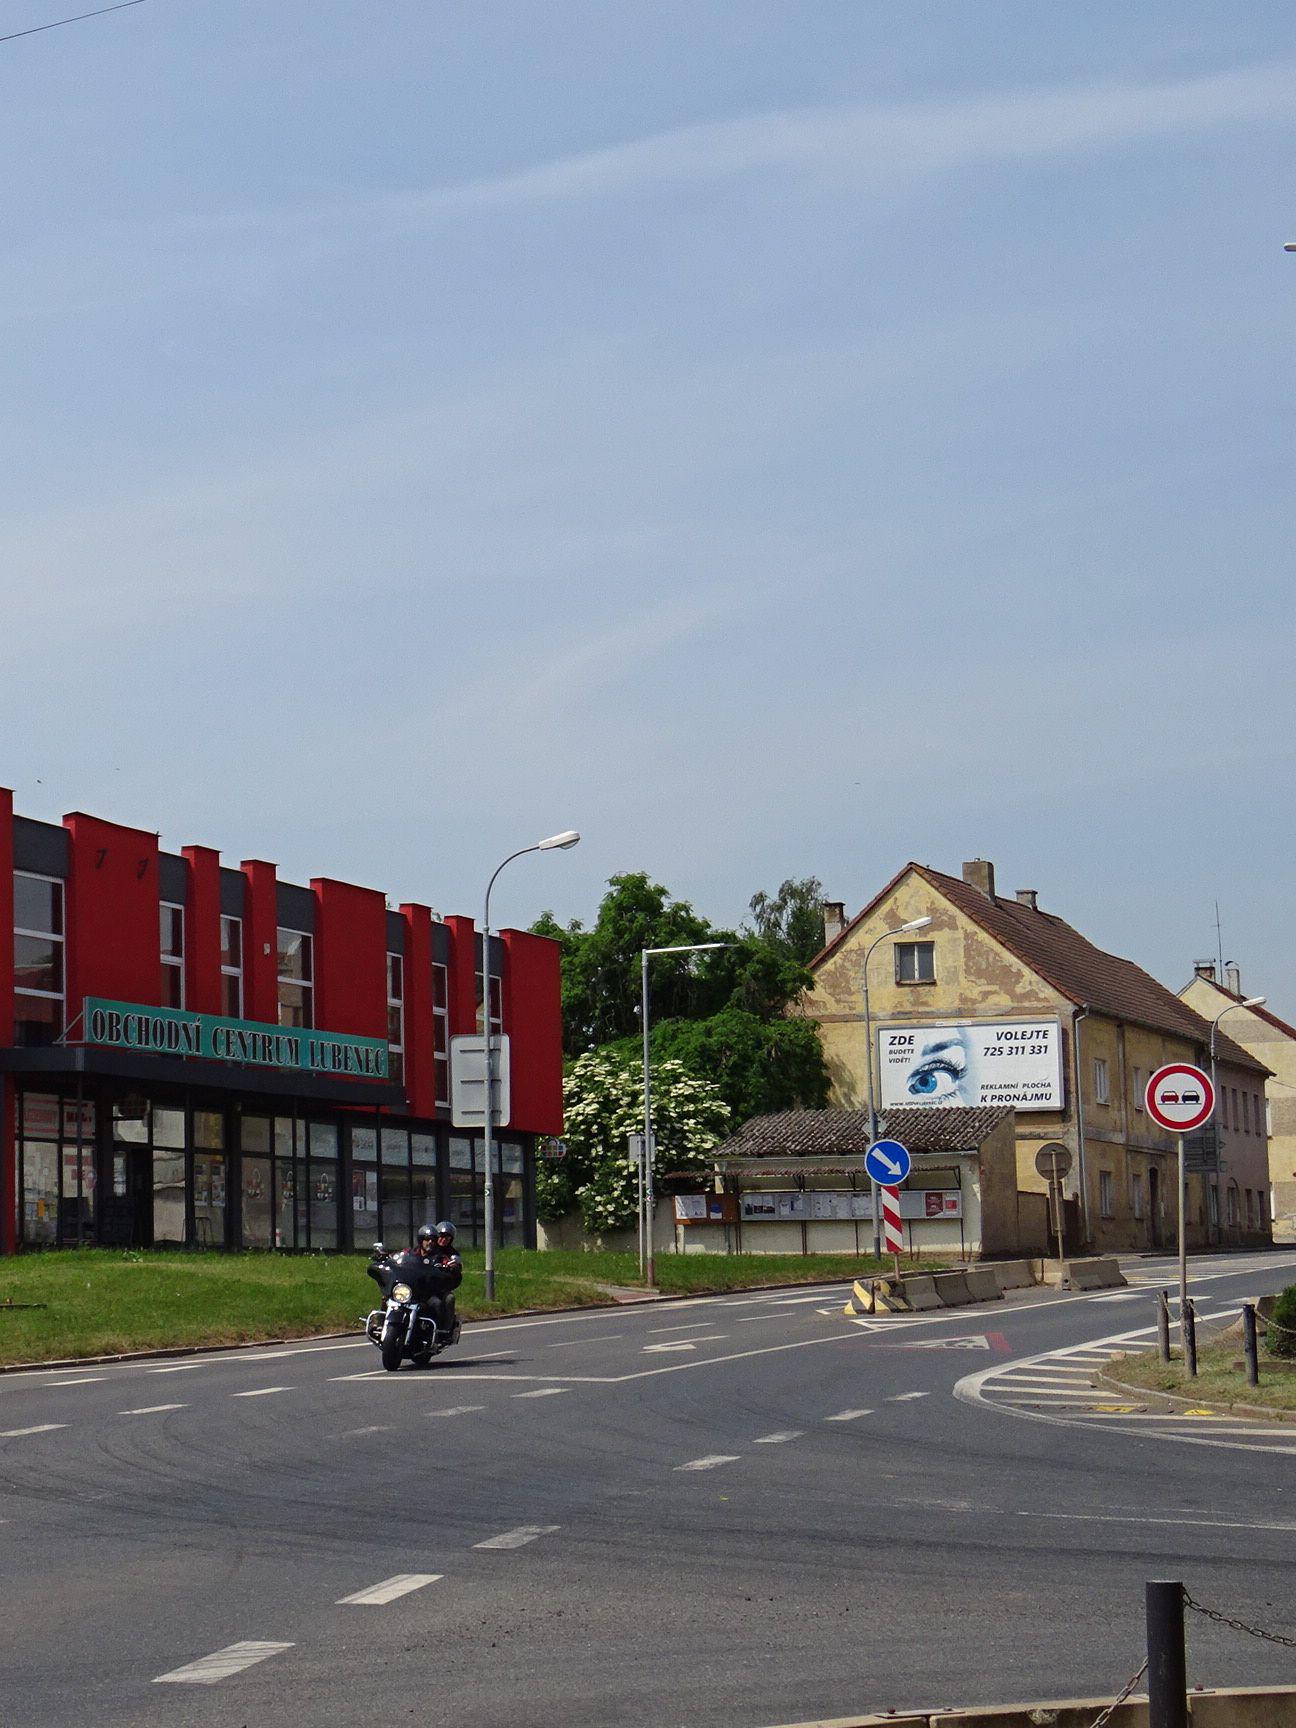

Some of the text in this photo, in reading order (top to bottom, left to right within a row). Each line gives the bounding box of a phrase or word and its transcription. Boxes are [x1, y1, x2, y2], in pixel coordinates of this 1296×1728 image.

[888, 1035, 915, 1046] ZDE
[996, 1029, 1049, 1041] VOLEJTE
[91, 1008, 386, 1077] OBCHODNÍ CENTRUM LUBENEC
[983, 1044, 1049, 1057] 725 311 331
[980, 1082, 1019, 1090] REKLAMNÍ
[980, 1091, 1052, 1103] K PRONÁJMU
